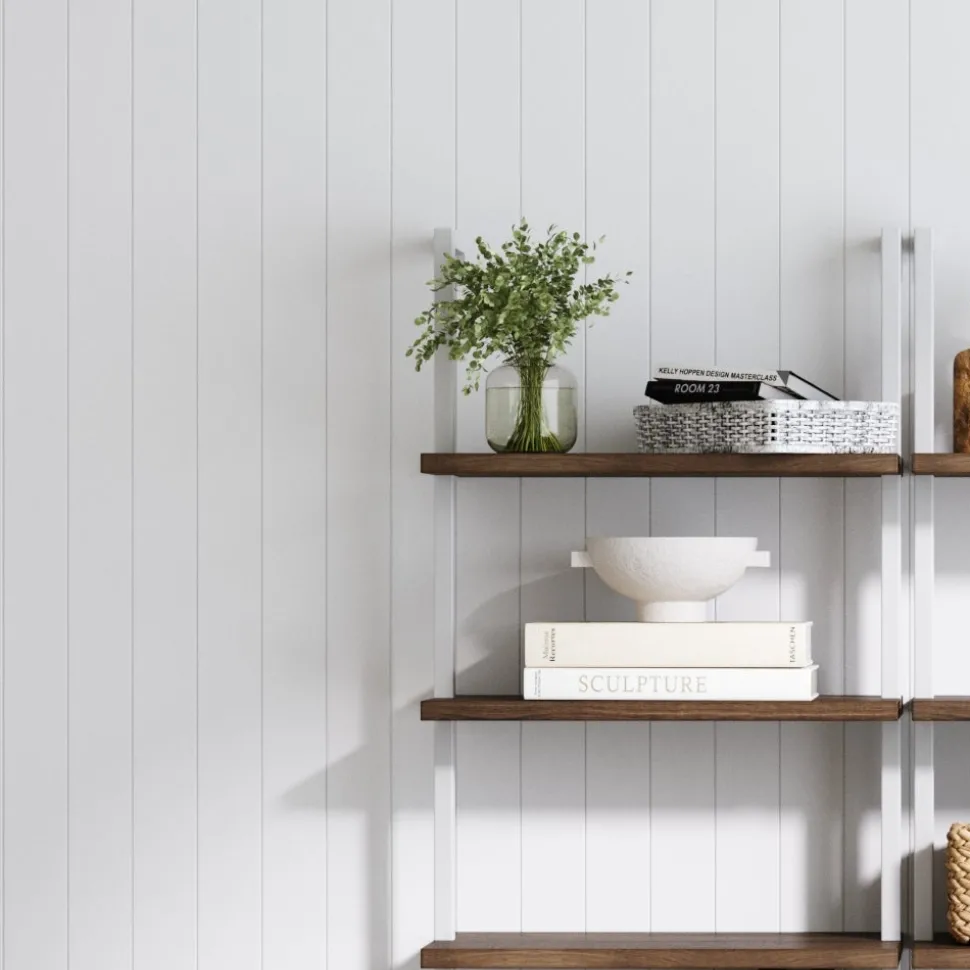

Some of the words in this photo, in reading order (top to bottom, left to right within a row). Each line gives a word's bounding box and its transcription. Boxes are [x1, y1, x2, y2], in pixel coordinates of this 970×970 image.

[658, 367, 678, 375] KELLY
[679, 368, 705, 377] HOPPEN
[706, 370, 729, 379] DESIGN
[730, 371, 777, 382] MASTERCLASS
[674, 383, 706, 394] ROOM
[707, 383, 721, 394] 23
[788, 626, 796, 663] TASCHEN
[578, 674, 708, 693] SCULPTURE
